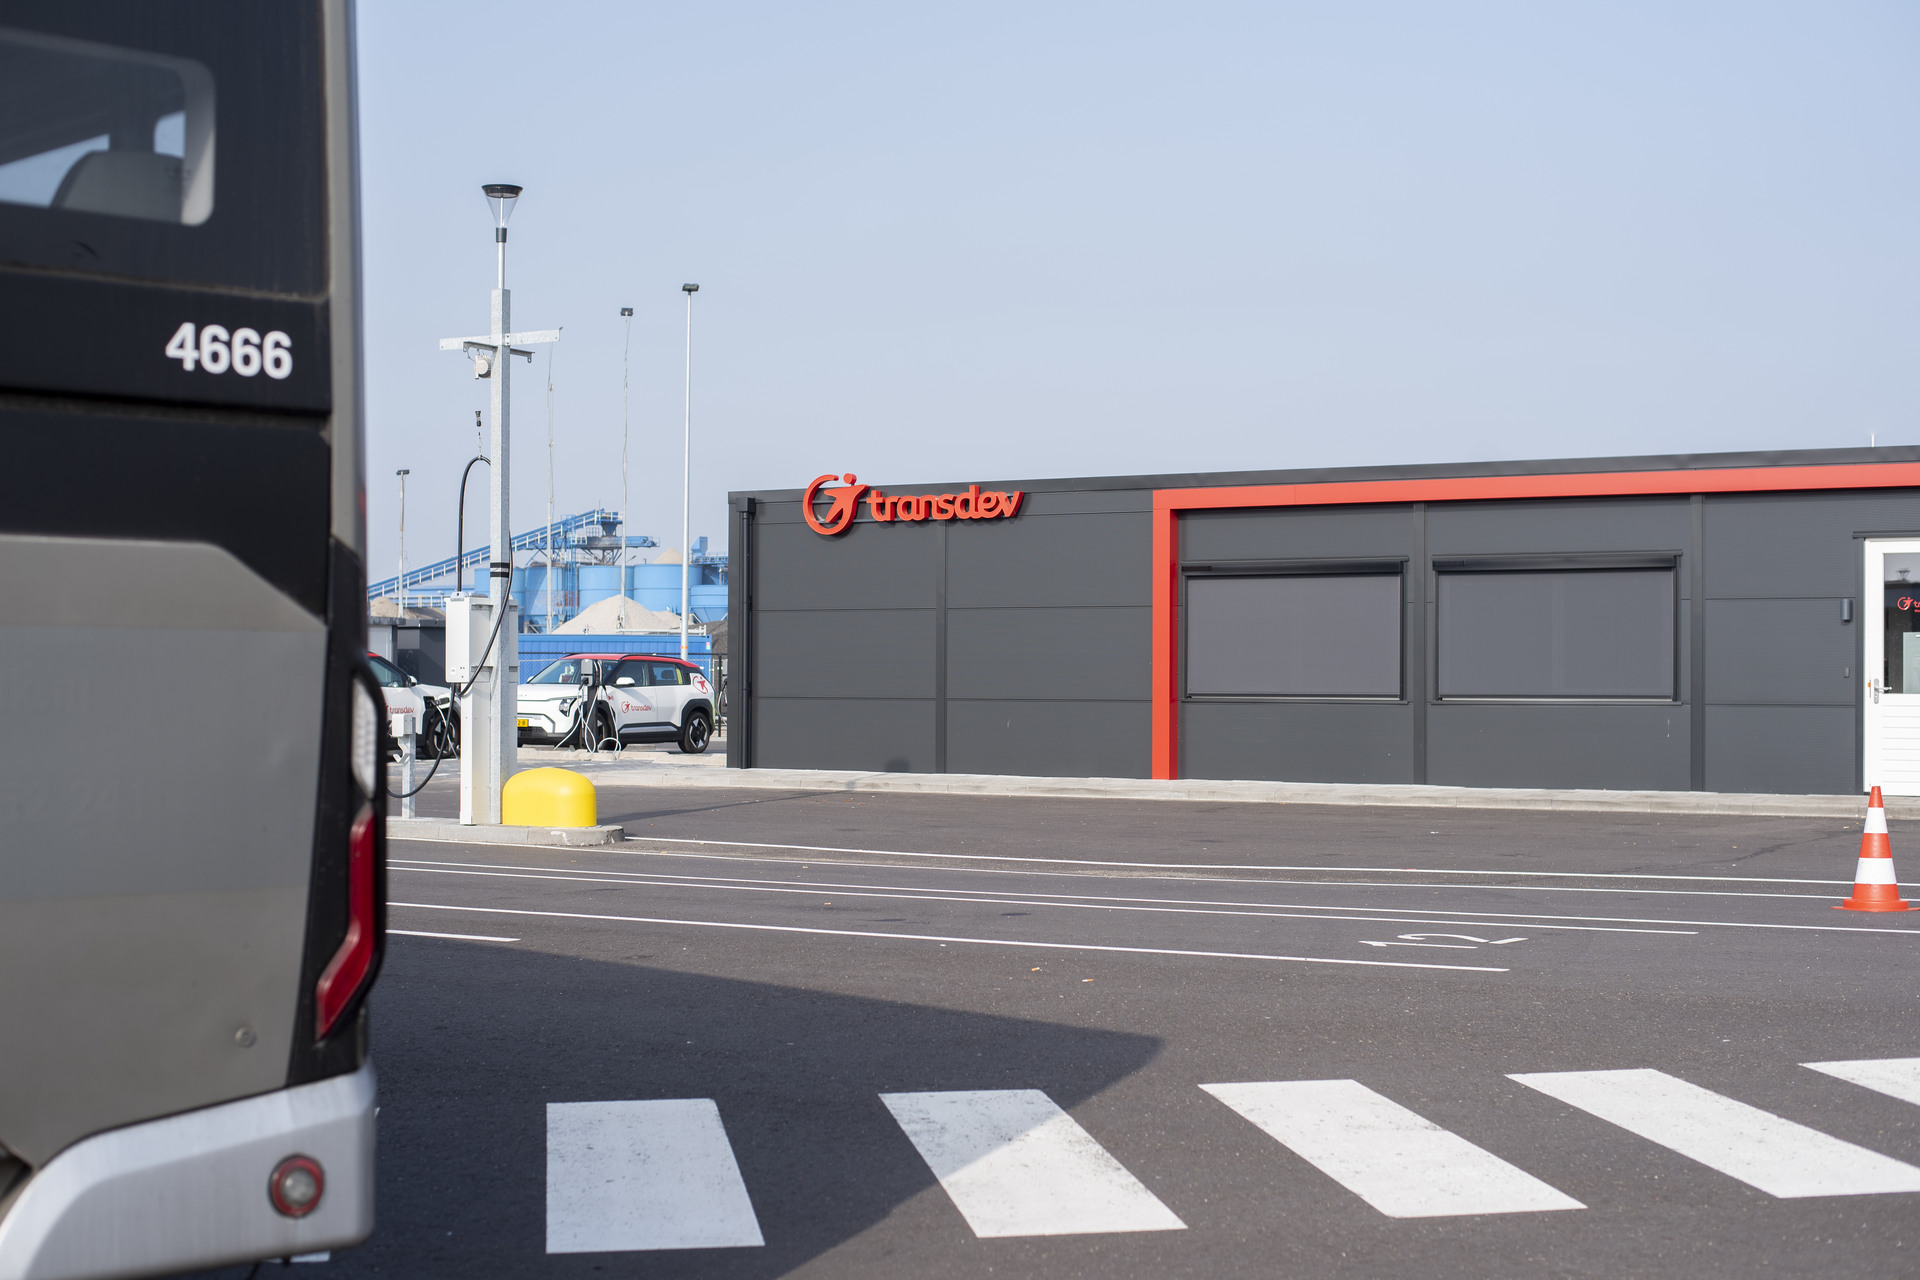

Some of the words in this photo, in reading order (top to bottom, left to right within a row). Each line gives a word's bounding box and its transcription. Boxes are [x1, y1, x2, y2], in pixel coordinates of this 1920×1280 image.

[165, 322, 293, 380] 4666
[866, 484, 1024, 522] transdev
[389, 705, 415, 714] transdev
[630, 704, 653, 712] transdev
